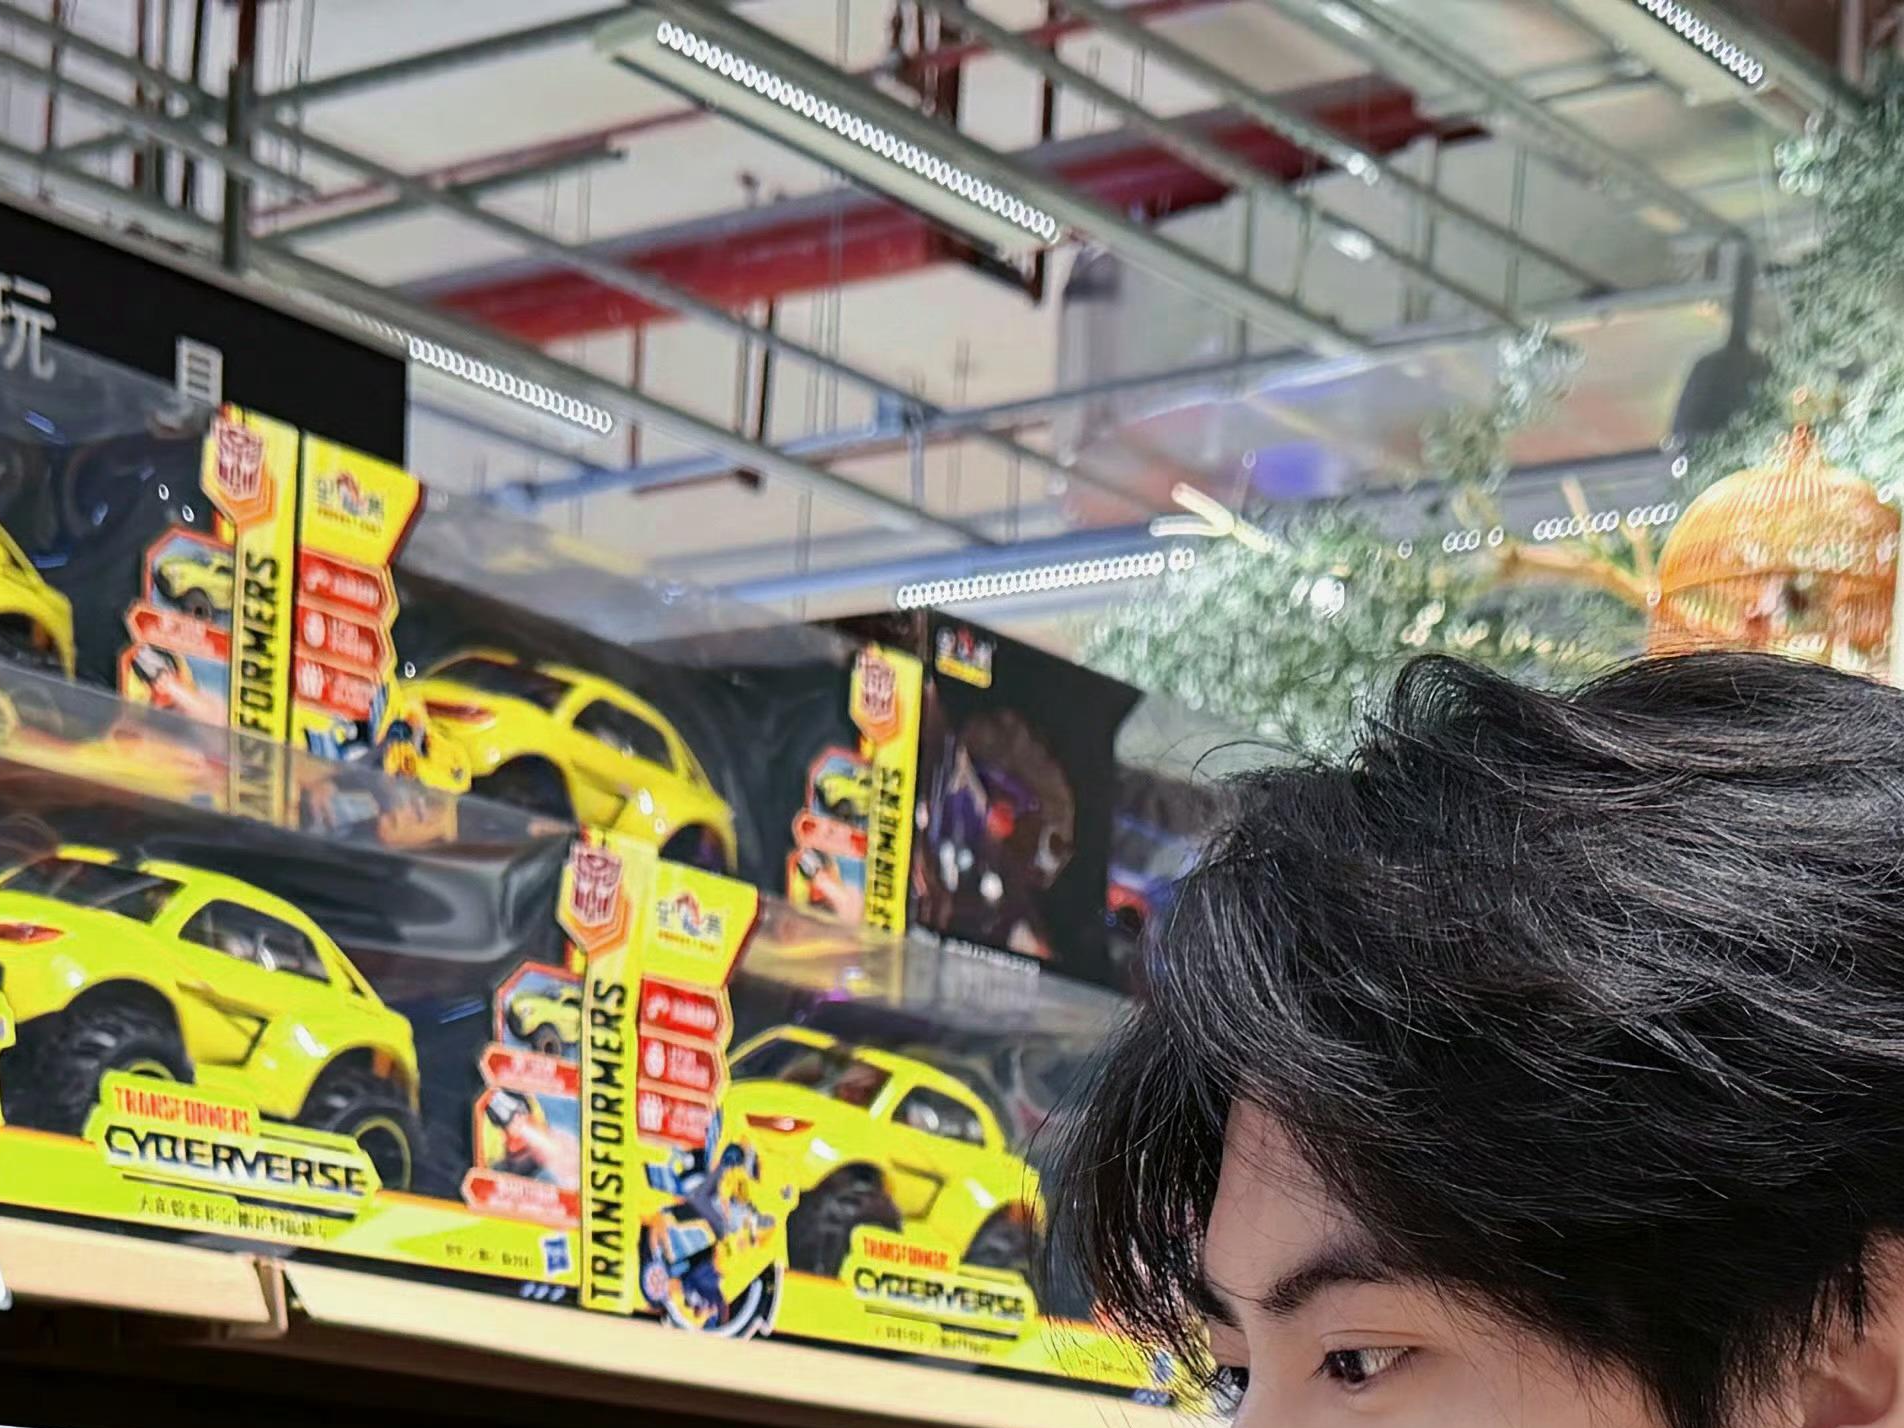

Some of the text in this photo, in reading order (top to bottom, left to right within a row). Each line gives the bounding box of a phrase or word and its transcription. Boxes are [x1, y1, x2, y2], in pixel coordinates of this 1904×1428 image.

[114, 1086, 252, 1135] TRANSFORMERS
[590, 979, 626, 1301] TRANSFORMERS
[105, 1125, 369, 1196] CYBERVERSE
